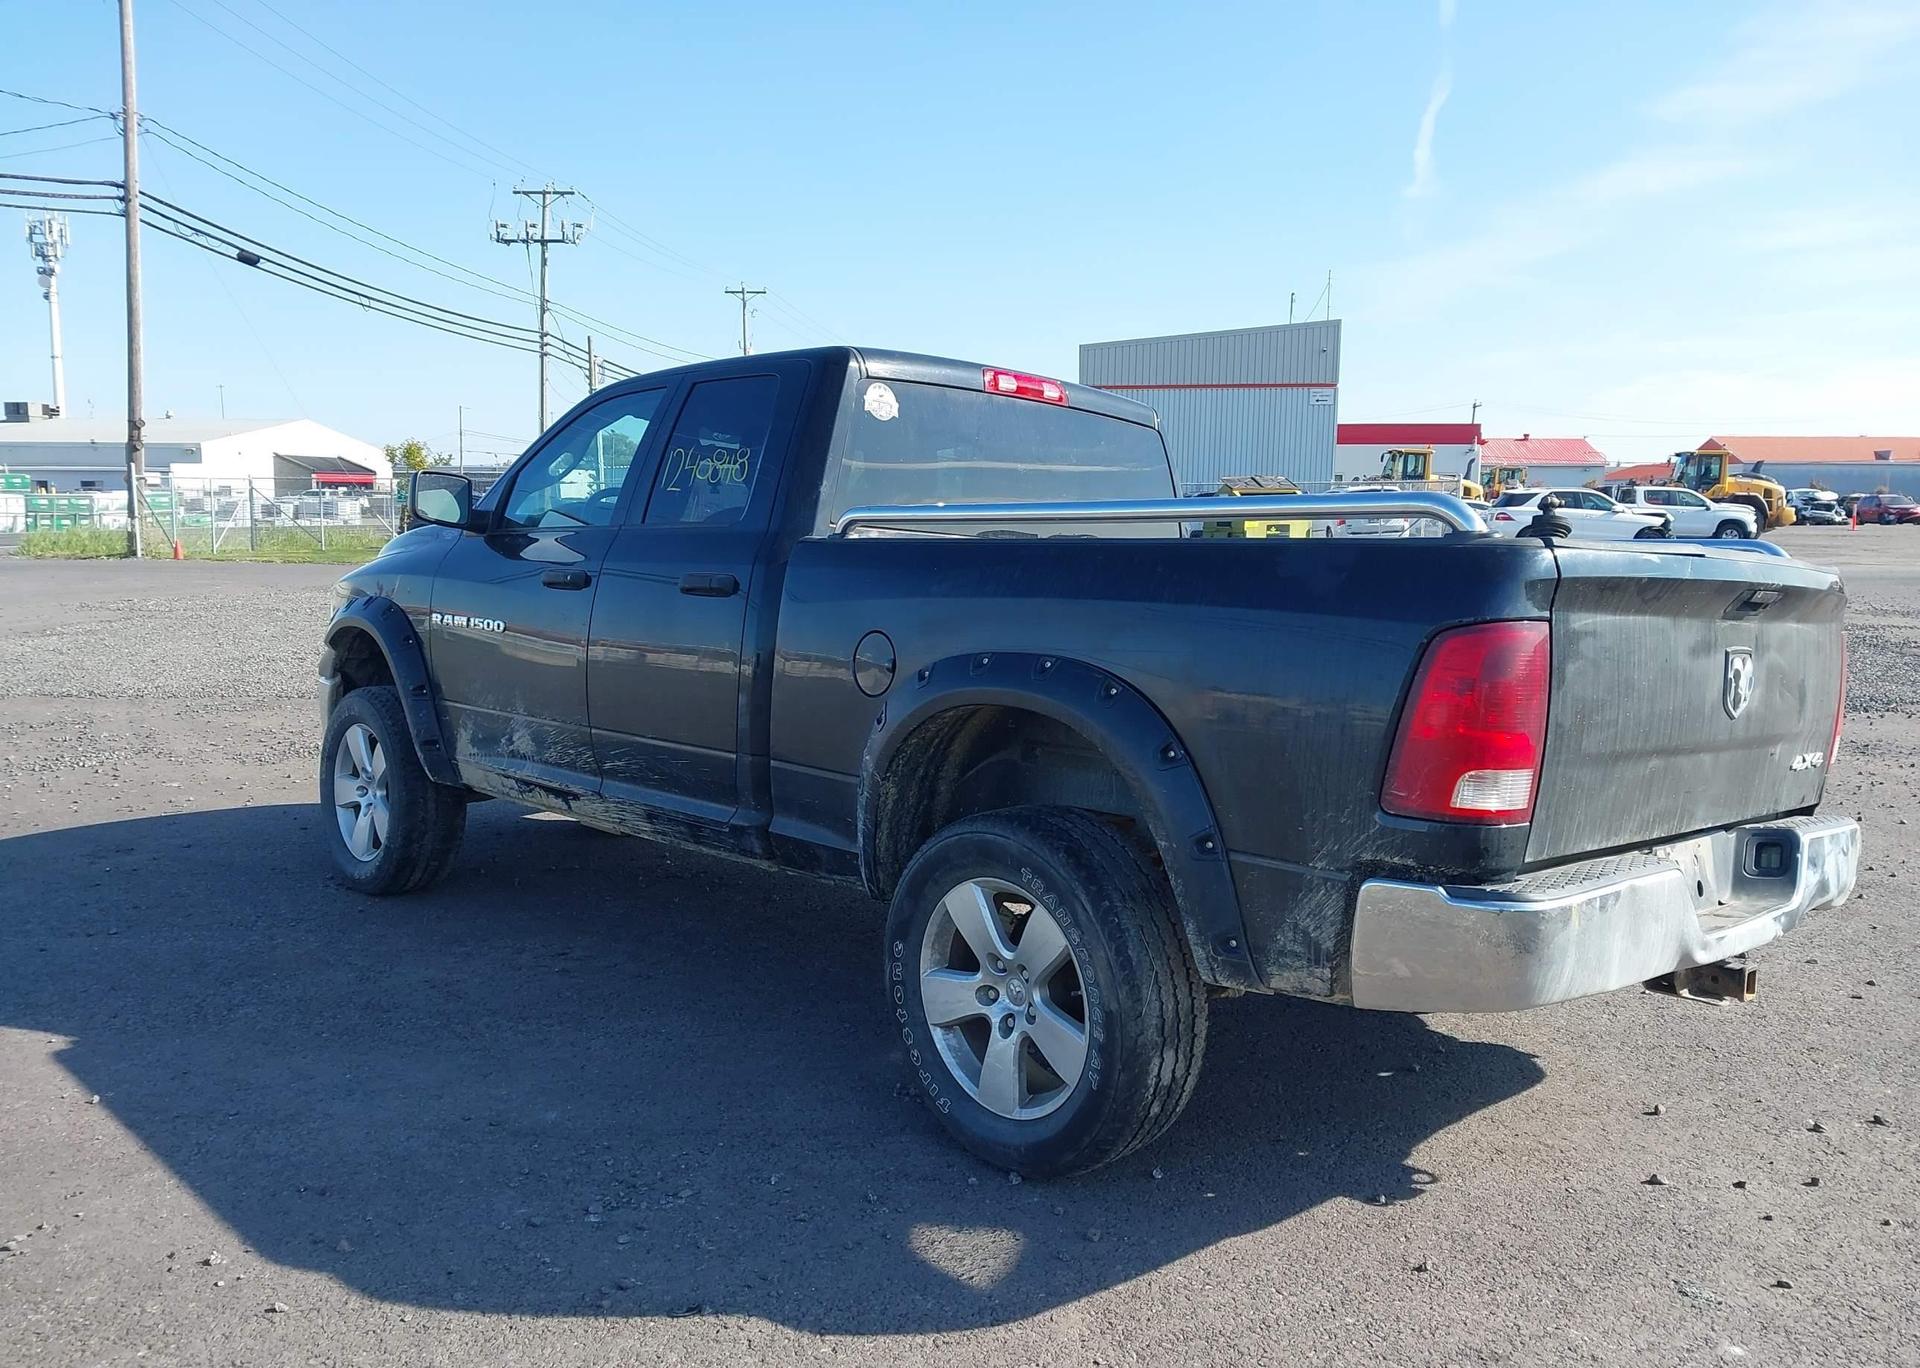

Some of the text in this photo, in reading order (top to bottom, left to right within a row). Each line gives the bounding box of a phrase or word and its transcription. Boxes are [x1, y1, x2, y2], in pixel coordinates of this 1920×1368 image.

[431, 612, 506, 633] RAM 1500
[1020, 866, 1103, 1090] TRANSFORCE AT
